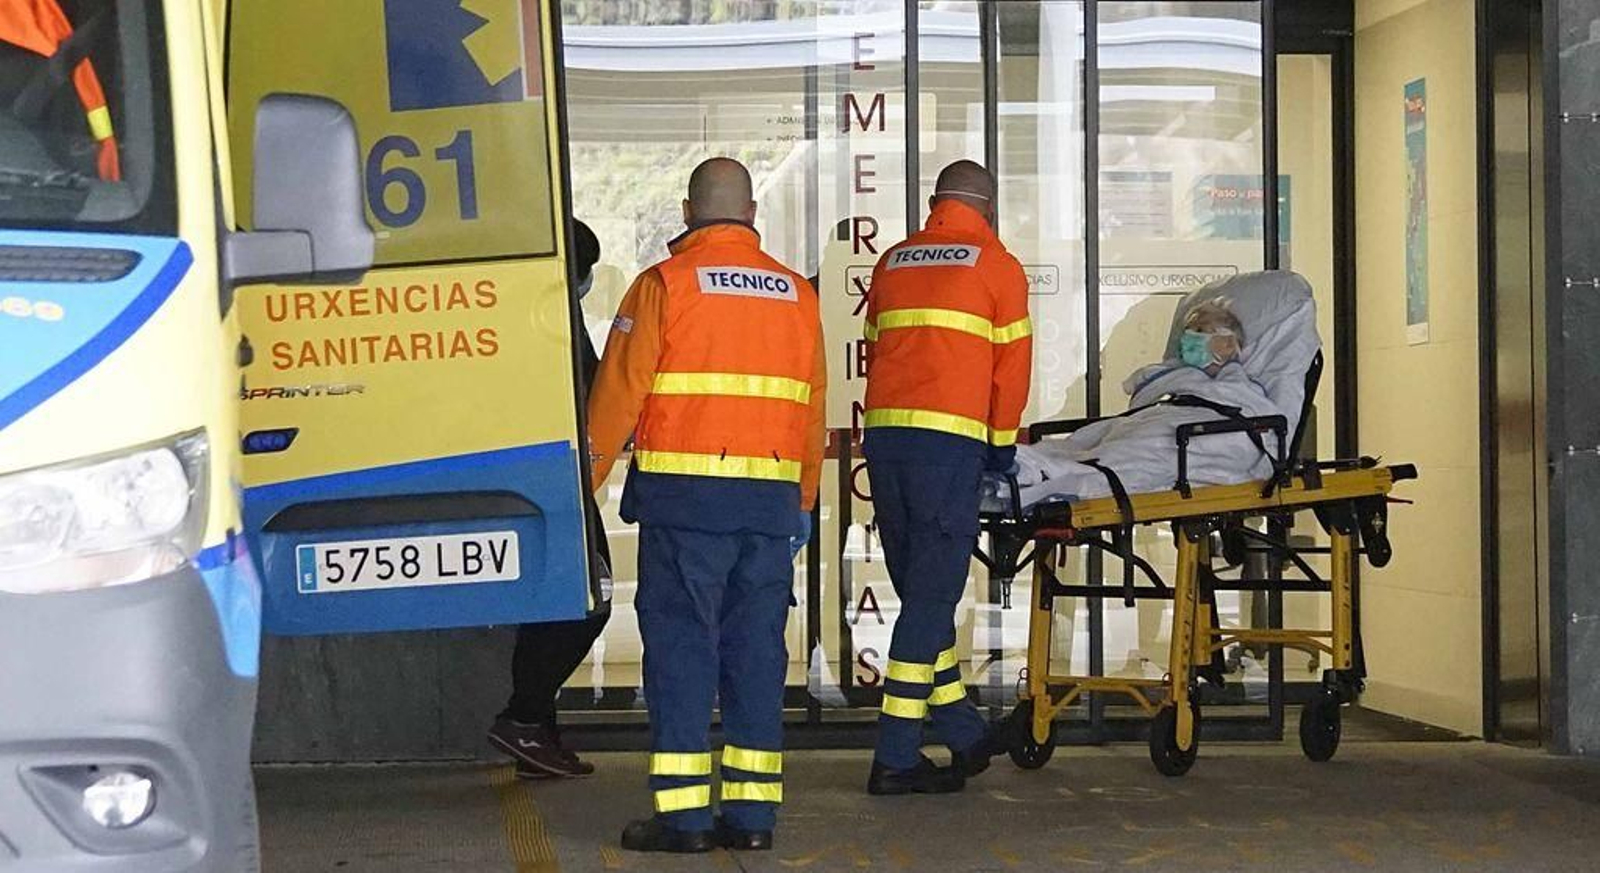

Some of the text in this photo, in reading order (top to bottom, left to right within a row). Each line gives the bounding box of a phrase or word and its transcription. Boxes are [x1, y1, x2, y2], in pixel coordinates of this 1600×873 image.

[895, 246, 970, 264] TECNICO
[706, 271, 790, 294] TECNICO
[1099, 273, 1232, 287] XCLUSIVO URXENCIA
[266, 280, 498, 322] URXENCIAS
[272, 328, 499, 370] SANITARIAS
[240, 384, 366, 400] SPRINTER
[325, 544, 421, 584] 5758
[437, 539, 508, 577] LBV
